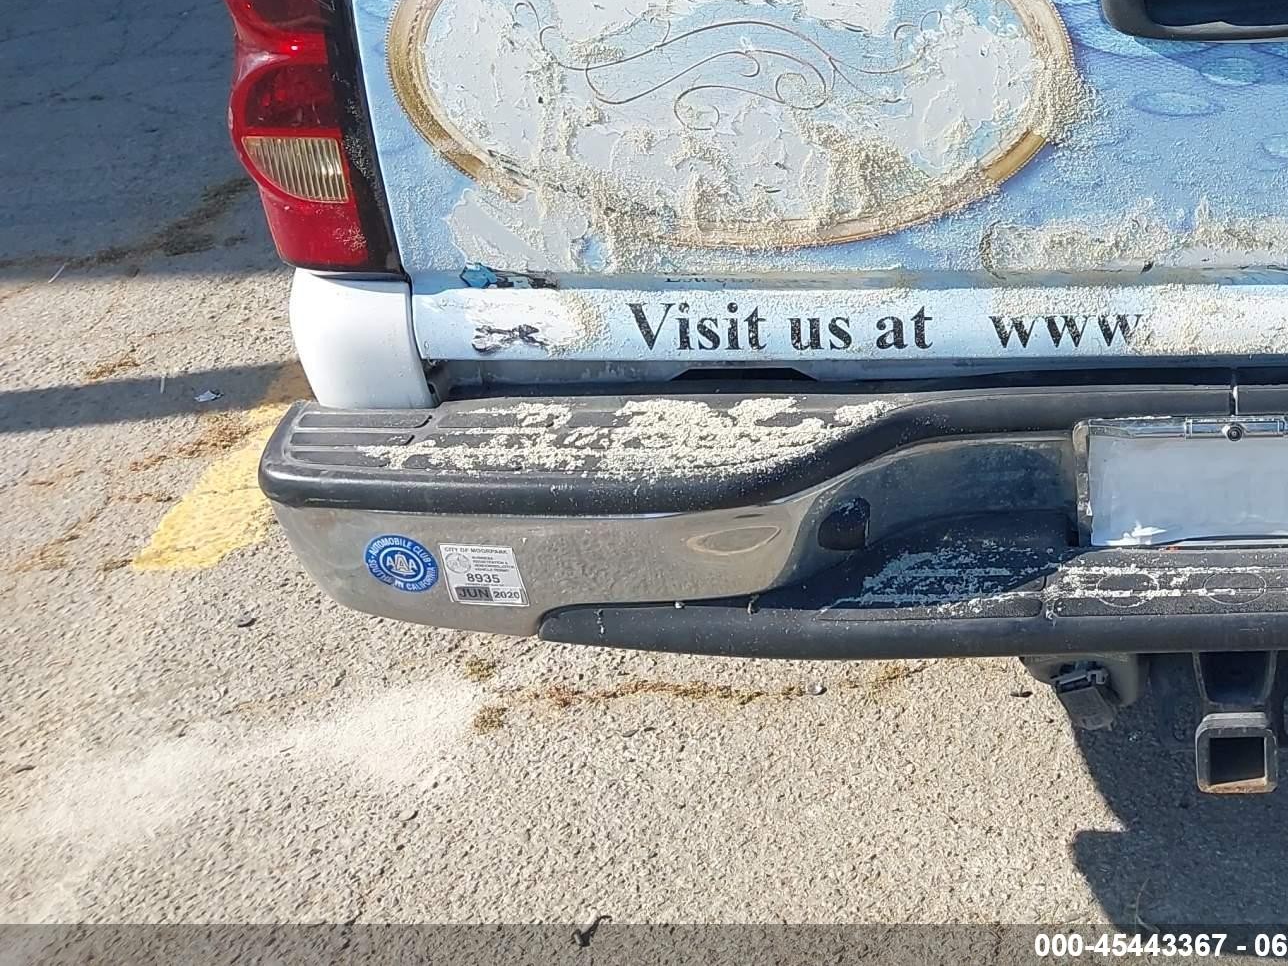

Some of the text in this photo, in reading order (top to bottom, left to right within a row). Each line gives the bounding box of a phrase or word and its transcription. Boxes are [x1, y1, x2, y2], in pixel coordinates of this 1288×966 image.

[628, 302, 766, 351] Visit
[790, 315, 852, 351] us
[876, 306, 933, 350] at
[369, 537, 431, 563] AUTOMOBILE CLUB
[386, 553, 418, 572] AAA
[466, 573, 501, 583] 8935
[459, 588, 490, 599] JUN
[493, 591, 520, 599] 2020
